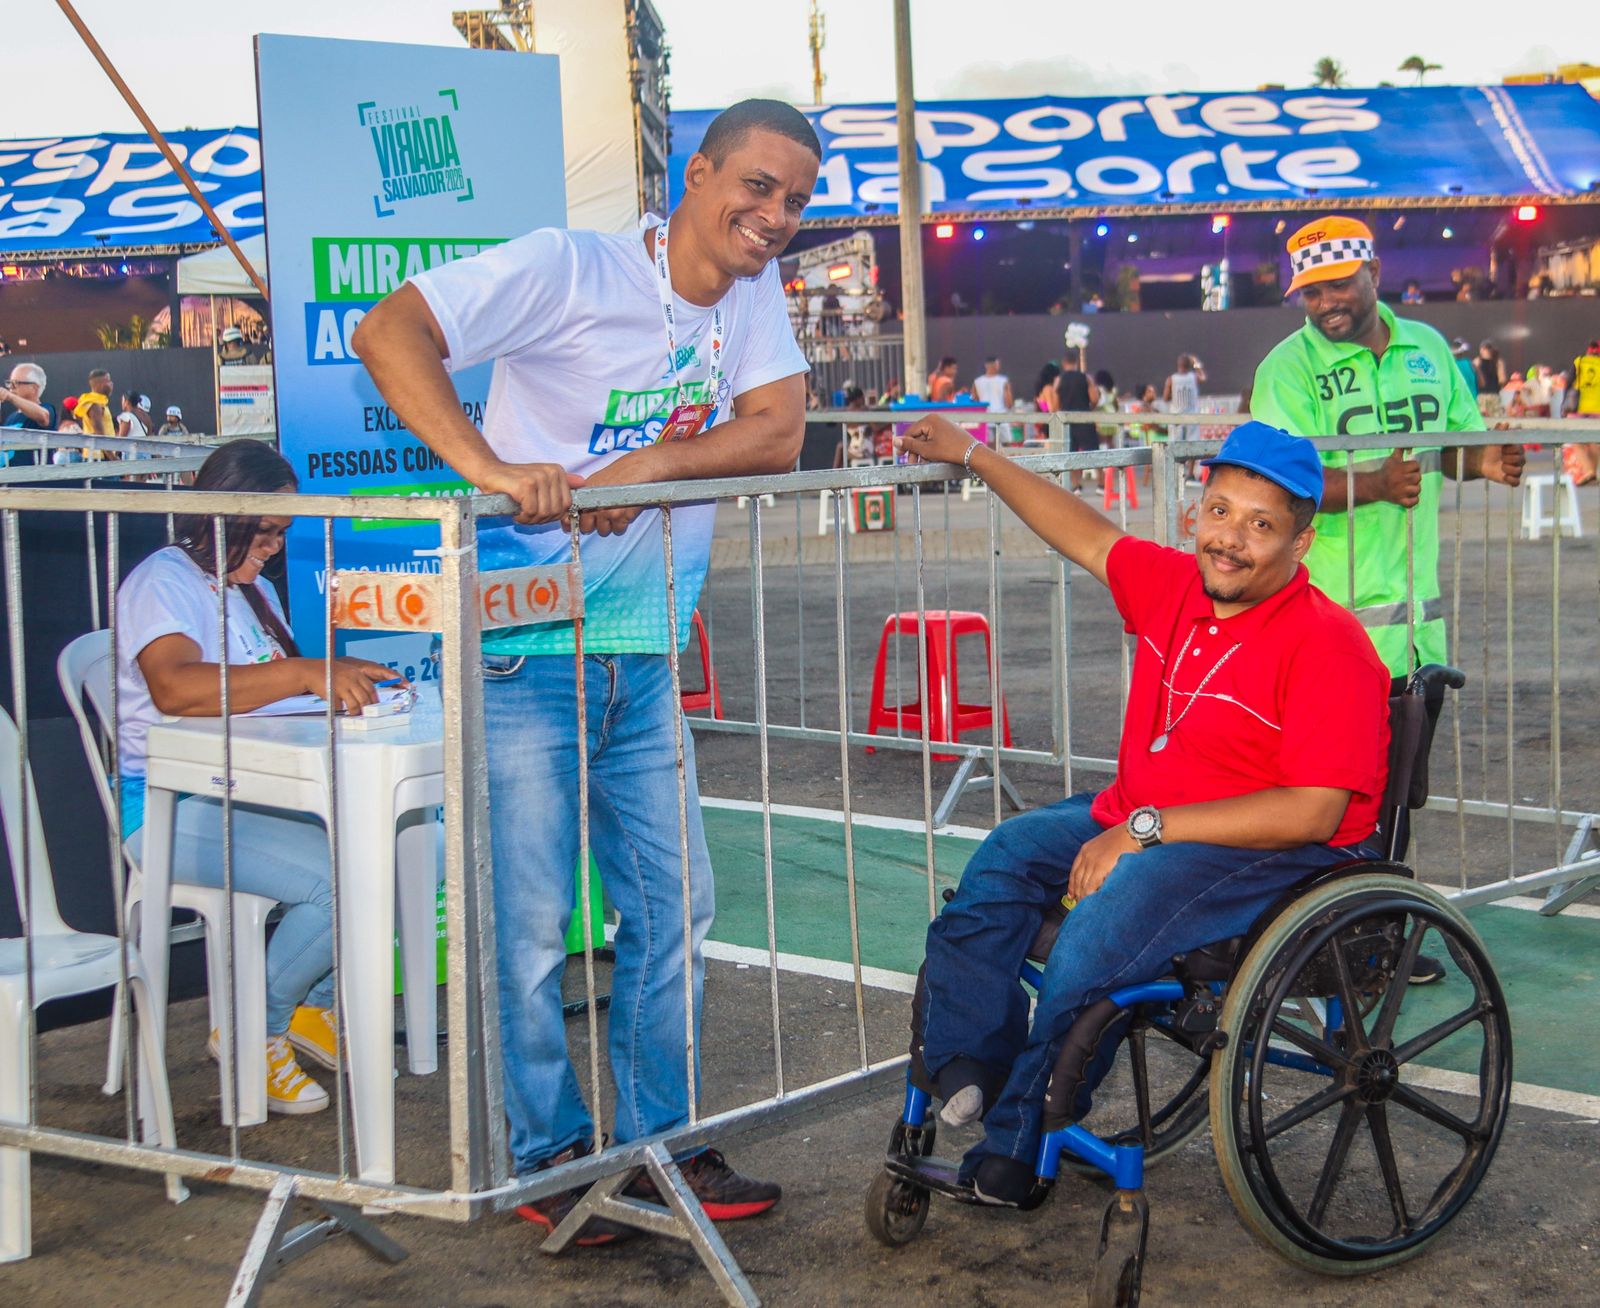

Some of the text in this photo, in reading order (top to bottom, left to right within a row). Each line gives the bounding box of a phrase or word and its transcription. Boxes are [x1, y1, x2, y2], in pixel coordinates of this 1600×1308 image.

[368, 104, 421, 125] FESTIVAL
[370, 115, 461, 179] VIRADA
[382, 171, 446, 203] SALVADOR
[1297, 231, 1327, 247] CSP
[1316, 367, 1361, 401] 312
[1337, 394, 1440, 435] CSP
[308, 446, 444, 479] PESSOAS COM
